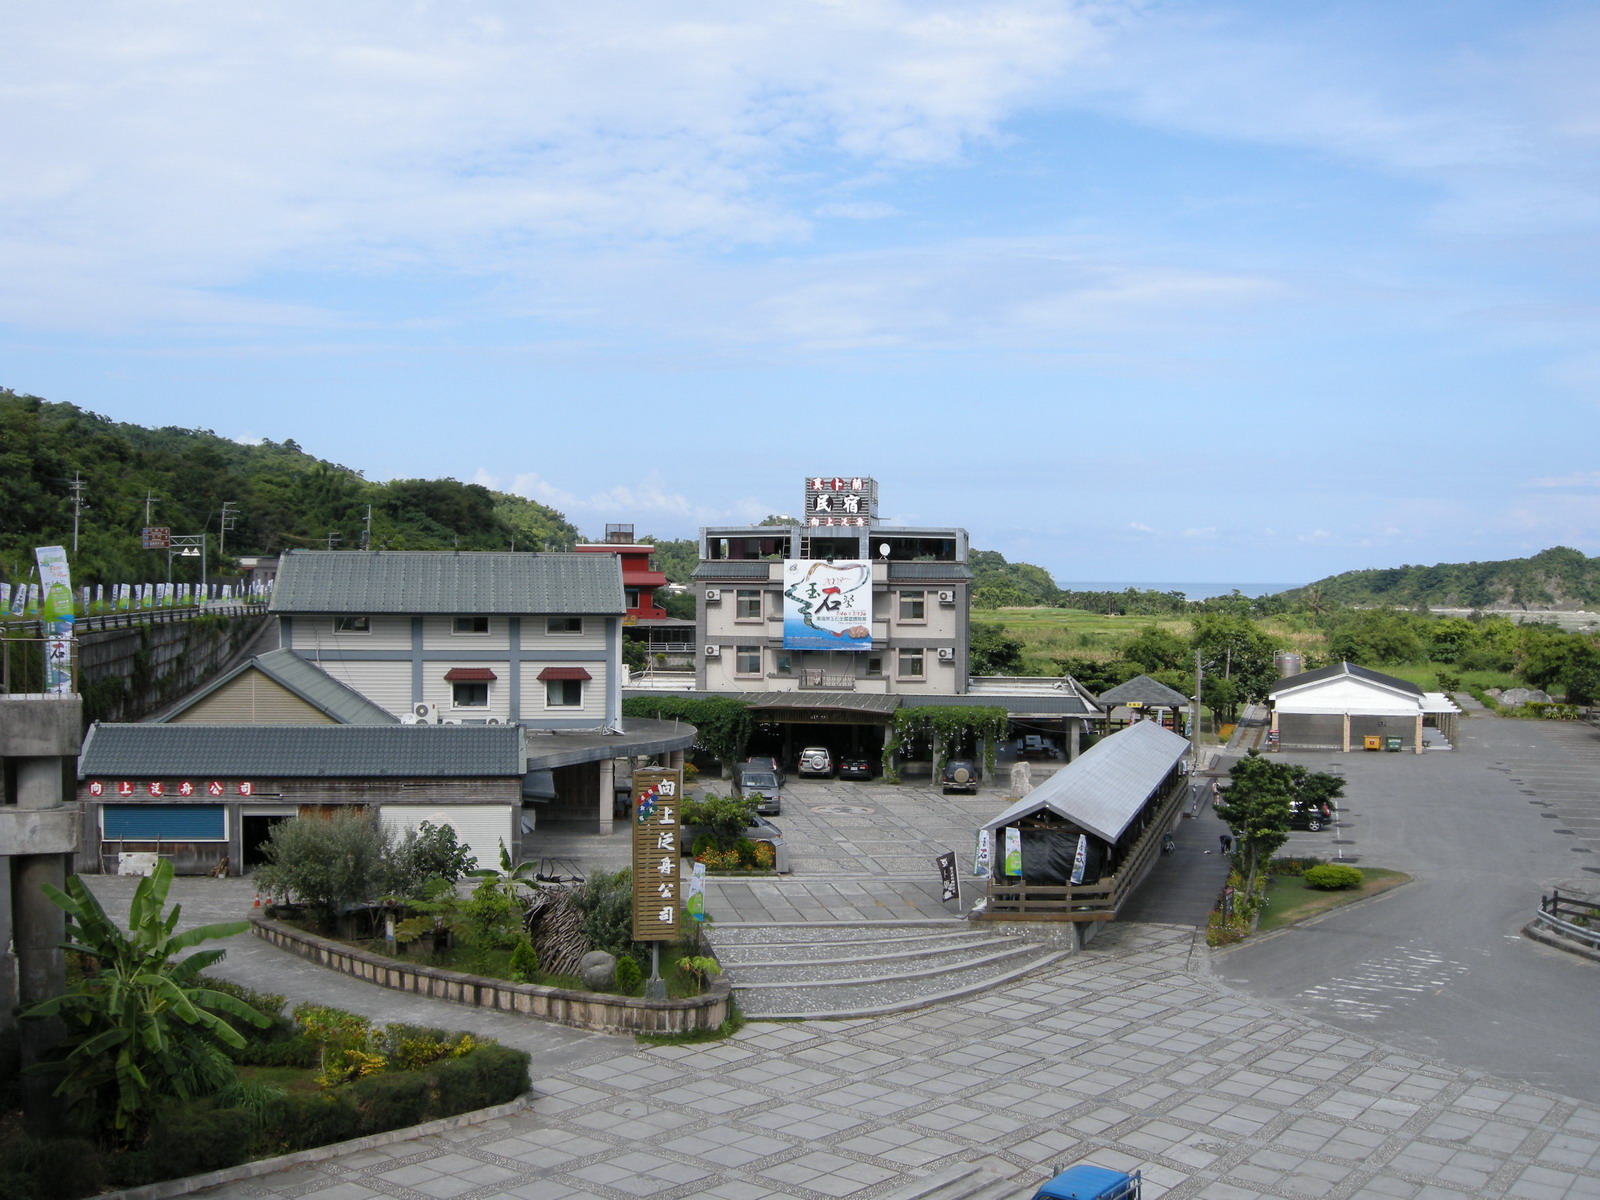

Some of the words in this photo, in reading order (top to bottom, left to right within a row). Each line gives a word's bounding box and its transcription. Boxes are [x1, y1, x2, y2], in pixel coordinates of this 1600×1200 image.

[815, 494, 861, 513] 民宿
[90, 781, 251, 796] 向上泛舟公司
[657, 778, 676, 924] 向上泛舟公司
